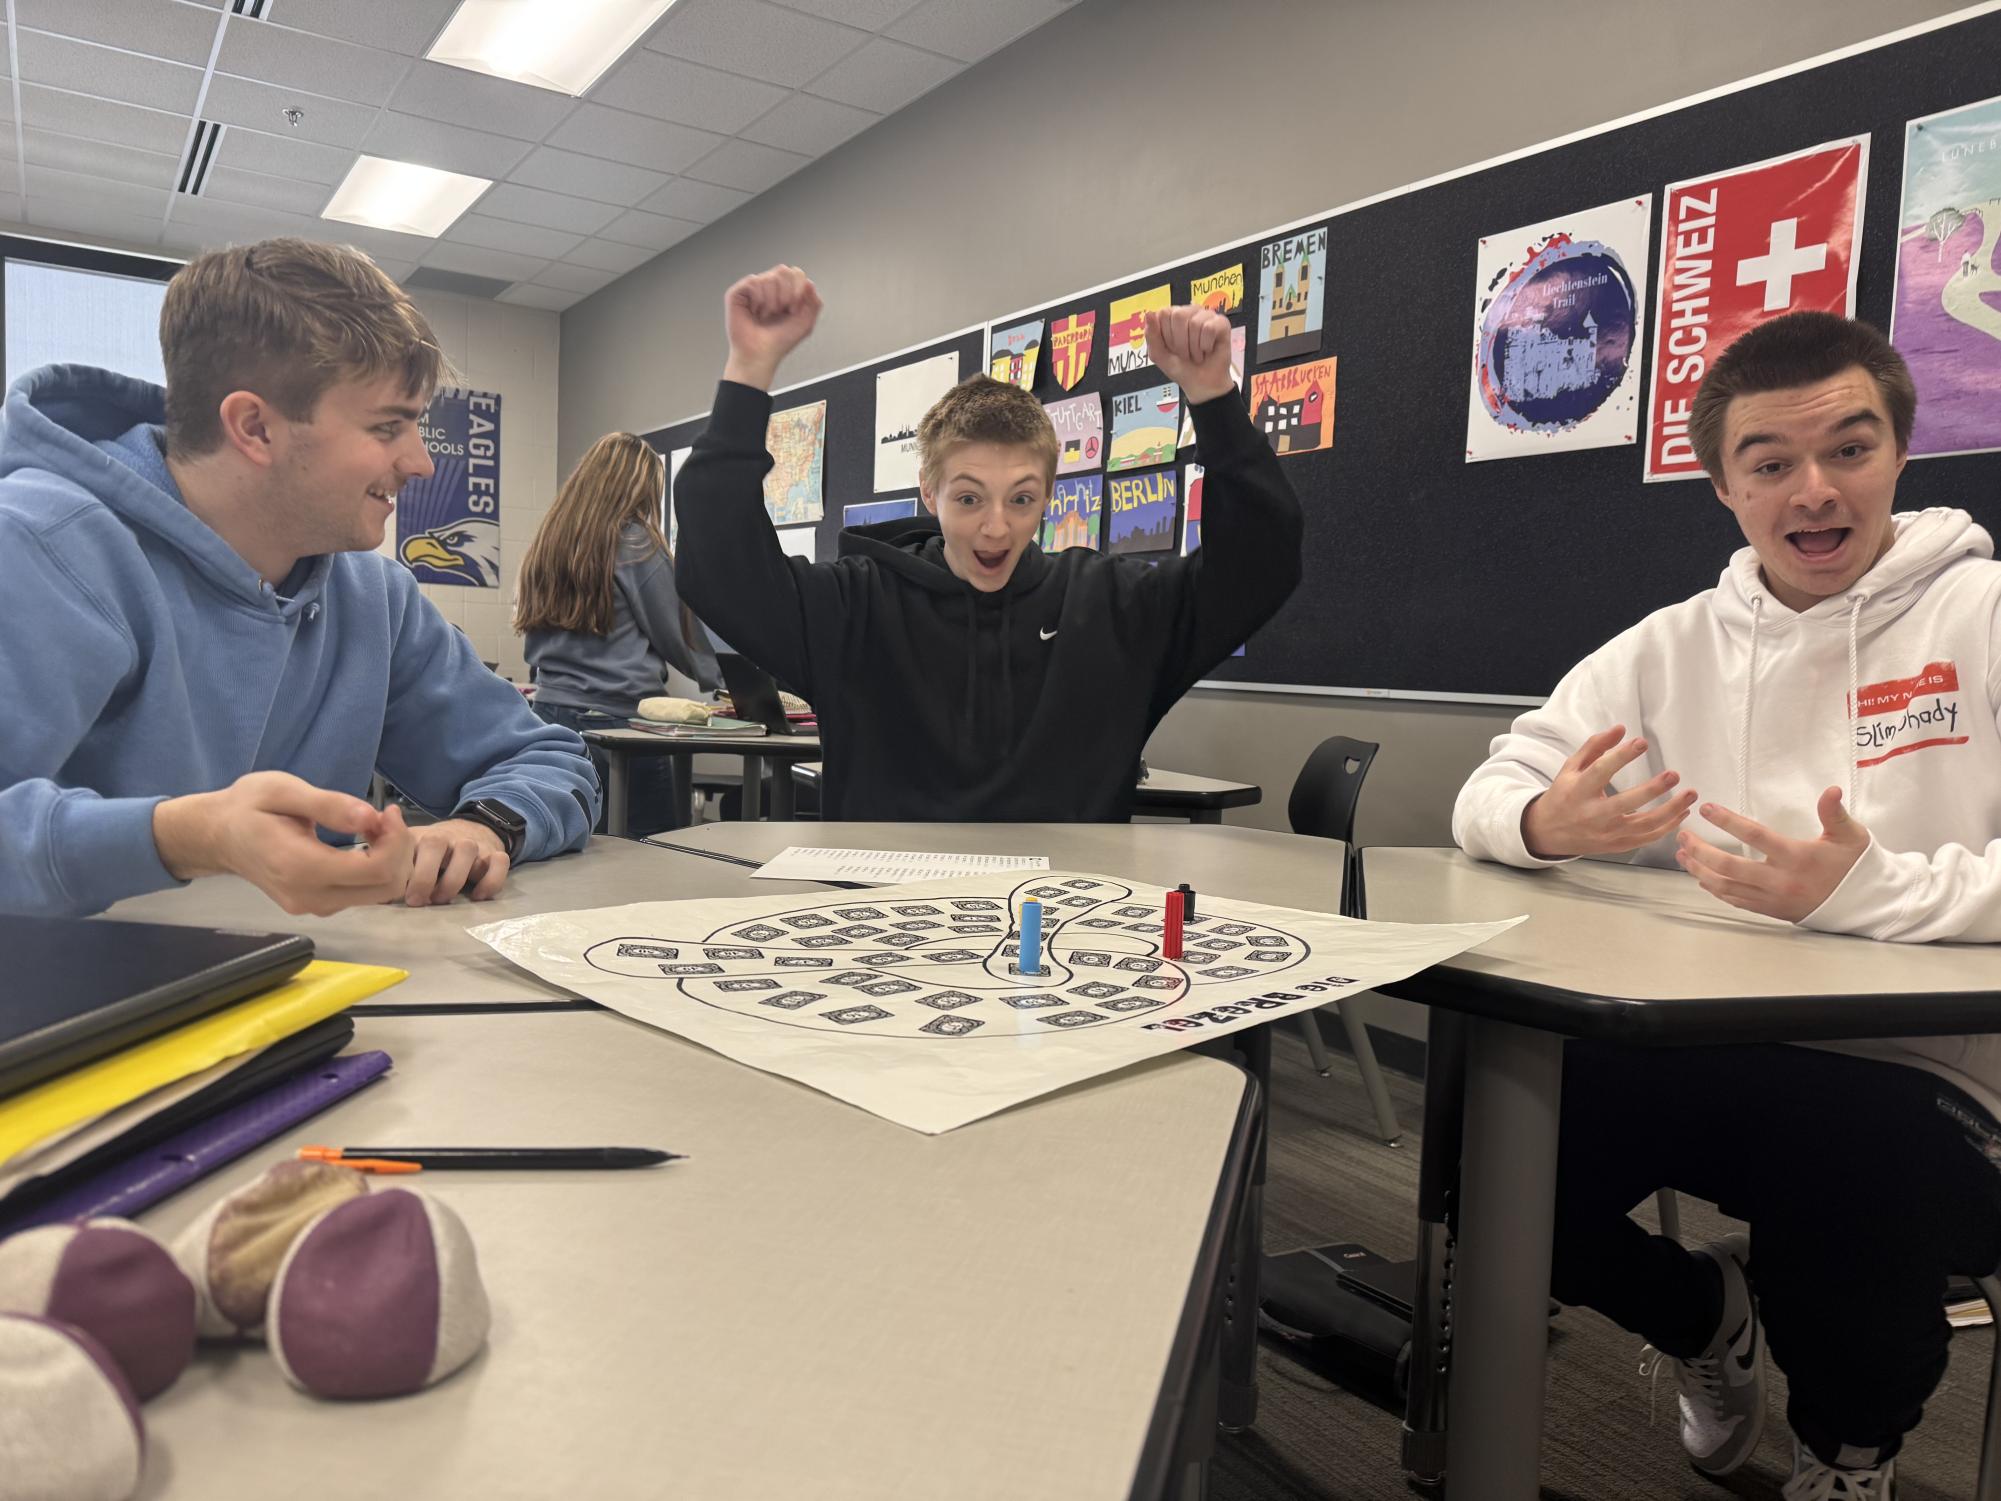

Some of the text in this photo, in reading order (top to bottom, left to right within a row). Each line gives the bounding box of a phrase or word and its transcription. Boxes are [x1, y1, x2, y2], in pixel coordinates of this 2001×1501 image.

[1261, 231, 1326, 269] BREMEN
[1543, 272, 1608, 297] Liechtenstein
[1553, 294, 1576, 309] Trail
[1660, 188, 1718, 466] DIE SCHWEIZ
[1046, 403, 1102, 431] TUTTGART
[1114, 395, 1142, 417] KIEL
[418, 426, 446, 440] BLIC
[468, 396, 495, 513] EAGLES
[1111, 472, 1175, 513] BERLIN
[1877, 693, 1899, 704] MY
[1928, 674, 1944, 684] IS
